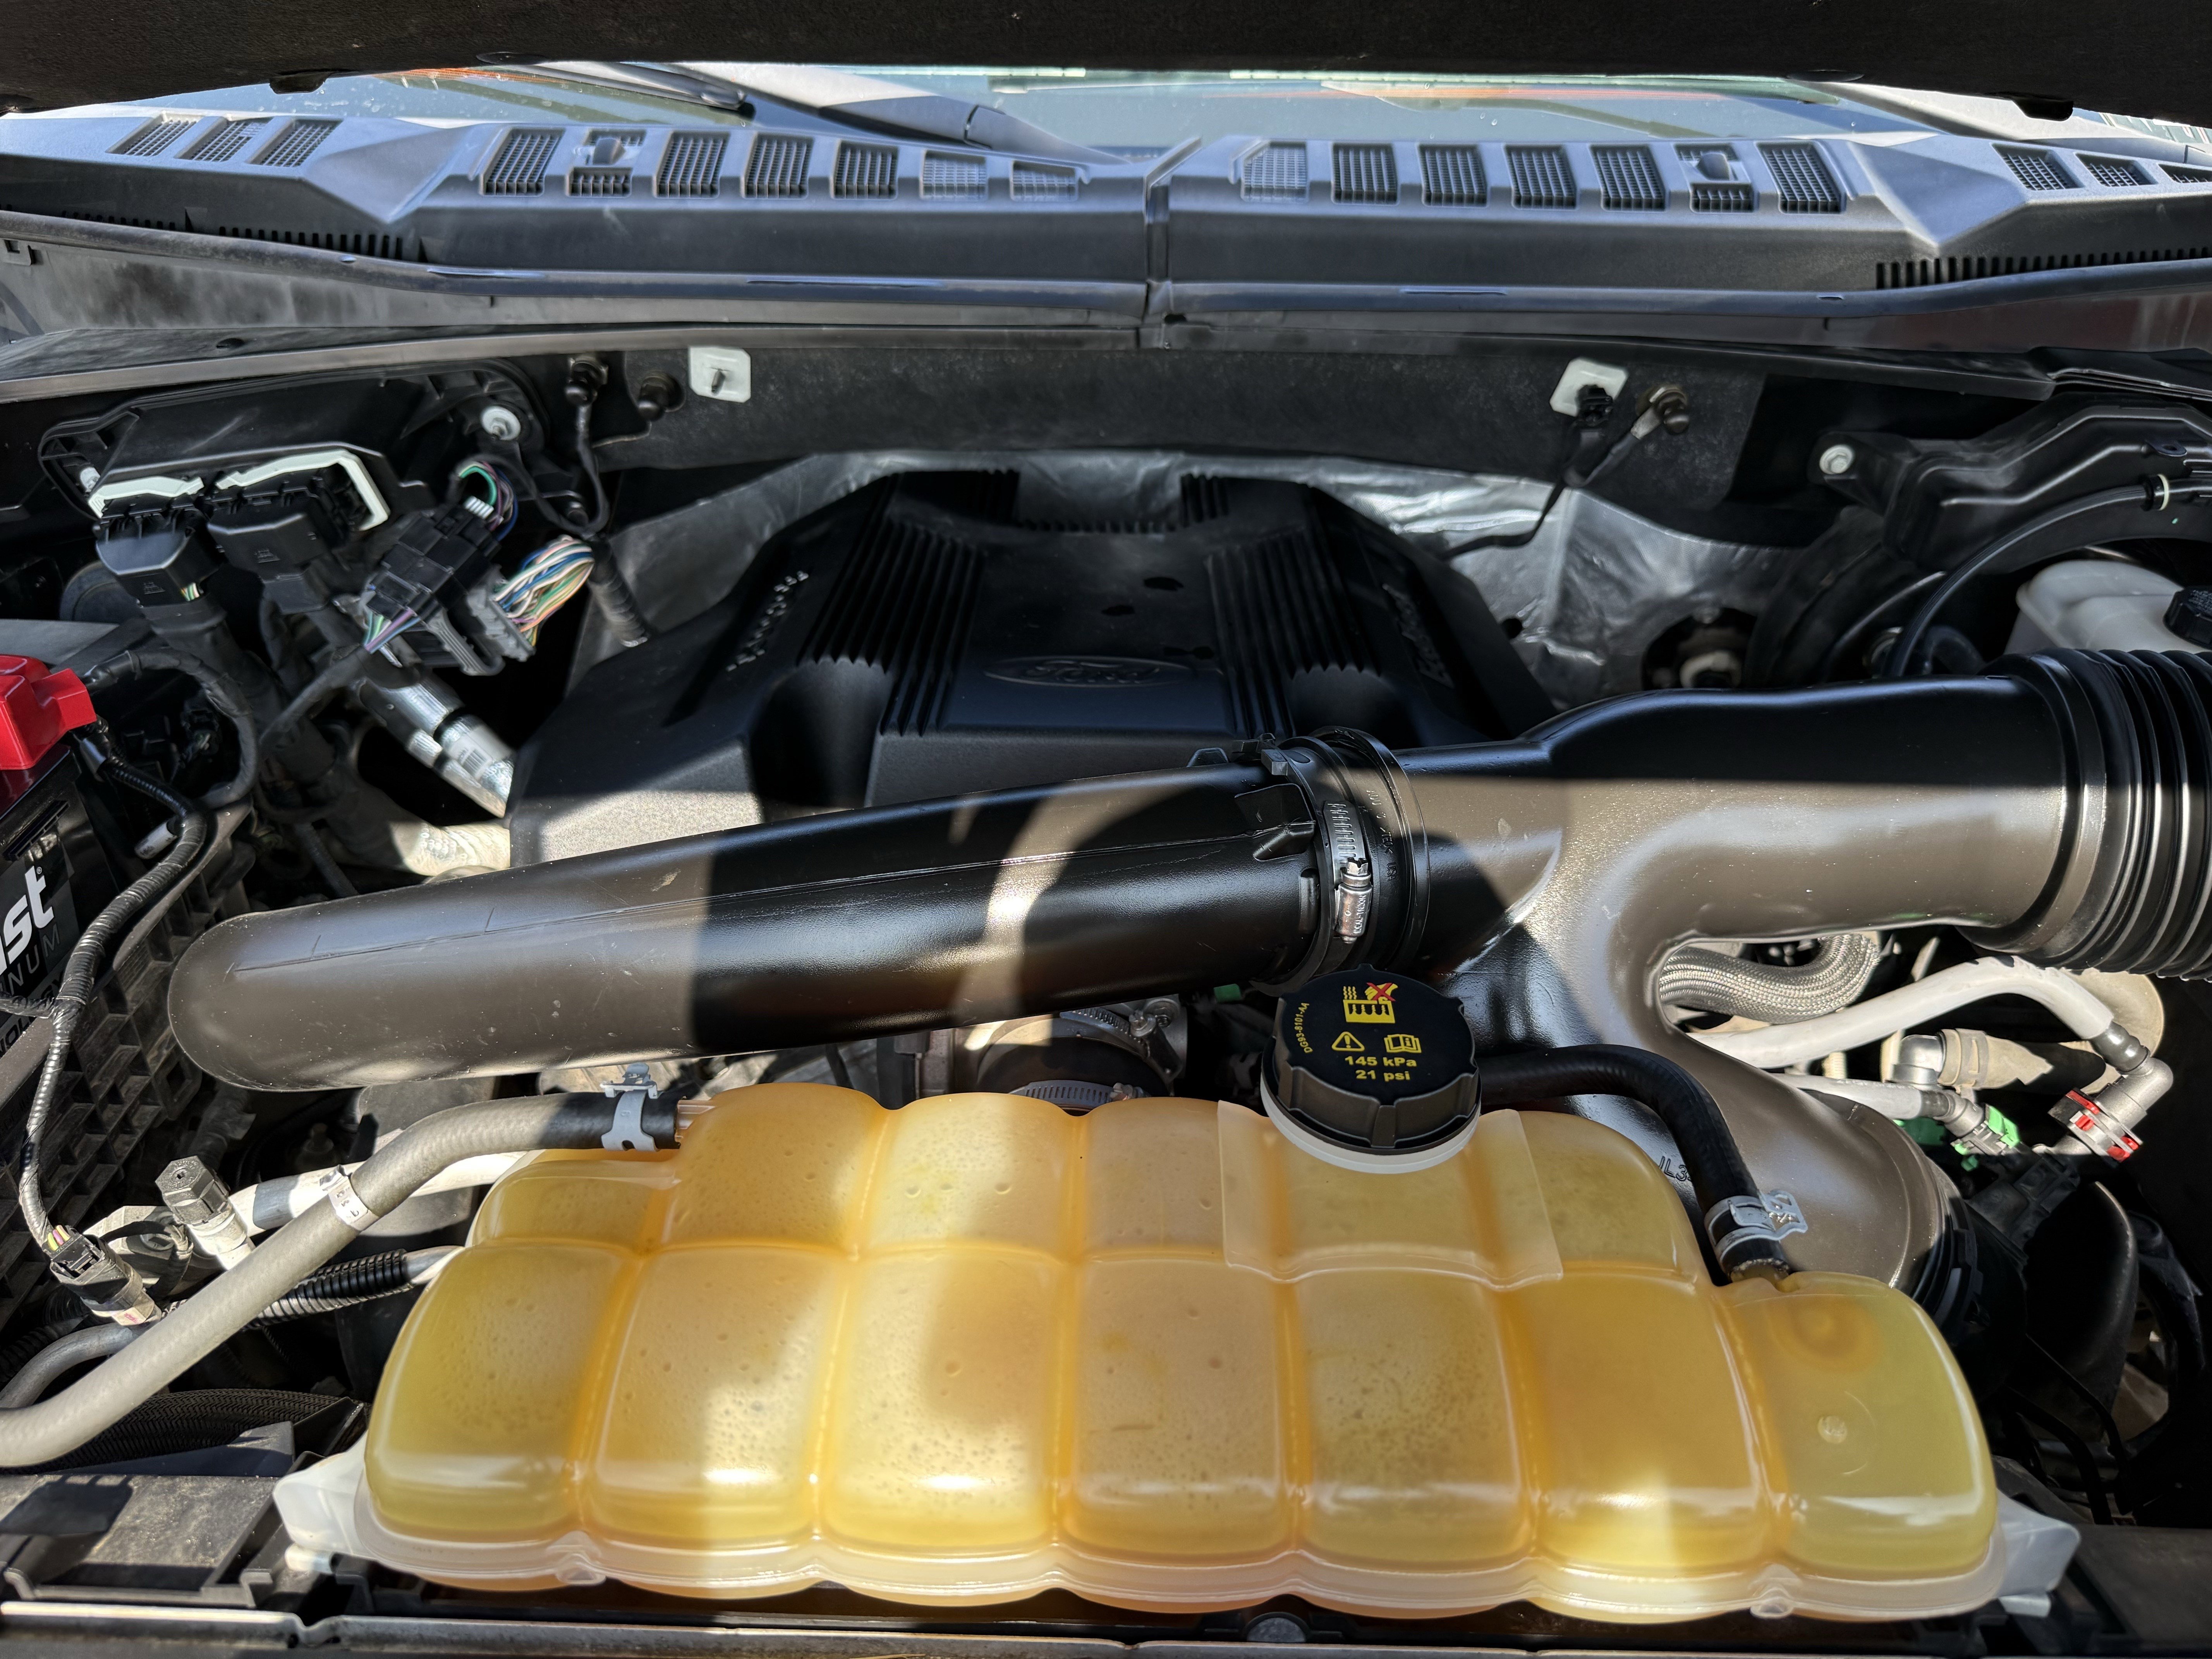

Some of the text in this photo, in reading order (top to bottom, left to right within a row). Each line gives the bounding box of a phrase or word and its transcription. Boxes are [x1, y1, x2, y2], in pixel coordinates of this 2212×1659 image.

[1386, 862, 1397, 881] USA
[0, 866, 54, 975] st
[1294, 1002, 1314, 1054] DG93-8101-AA
[1345, 1056, 1417, 1067] 145 kPa
[1355, 1070, 1410, 1082] 21 psi
